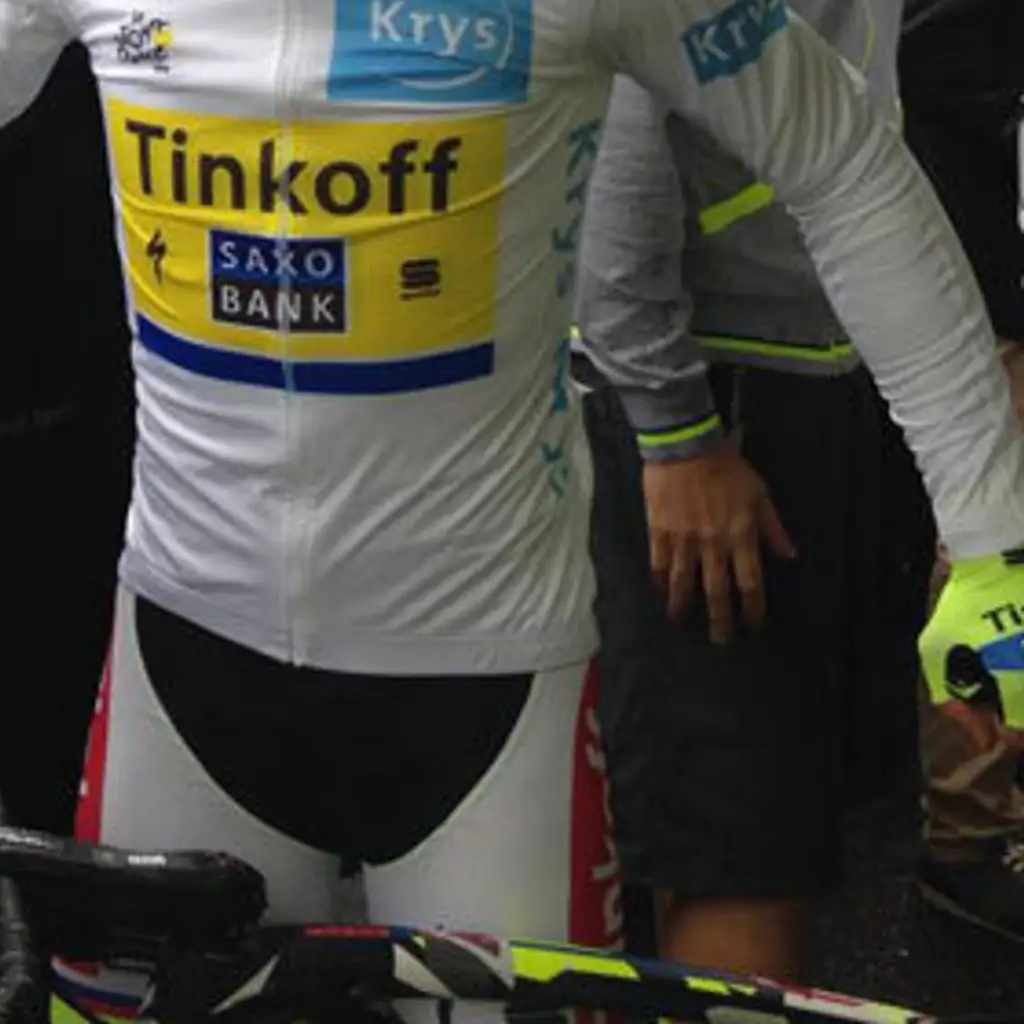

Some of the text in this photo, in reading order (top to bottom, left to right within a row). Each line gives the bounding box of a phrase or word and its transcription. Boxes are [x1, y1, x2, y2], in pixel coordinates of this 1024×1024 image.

[125, 118, 463, 217] Tinkoff
[219, 240, 336, 276] SAXO
[220, 285, 337, 323] BANK
